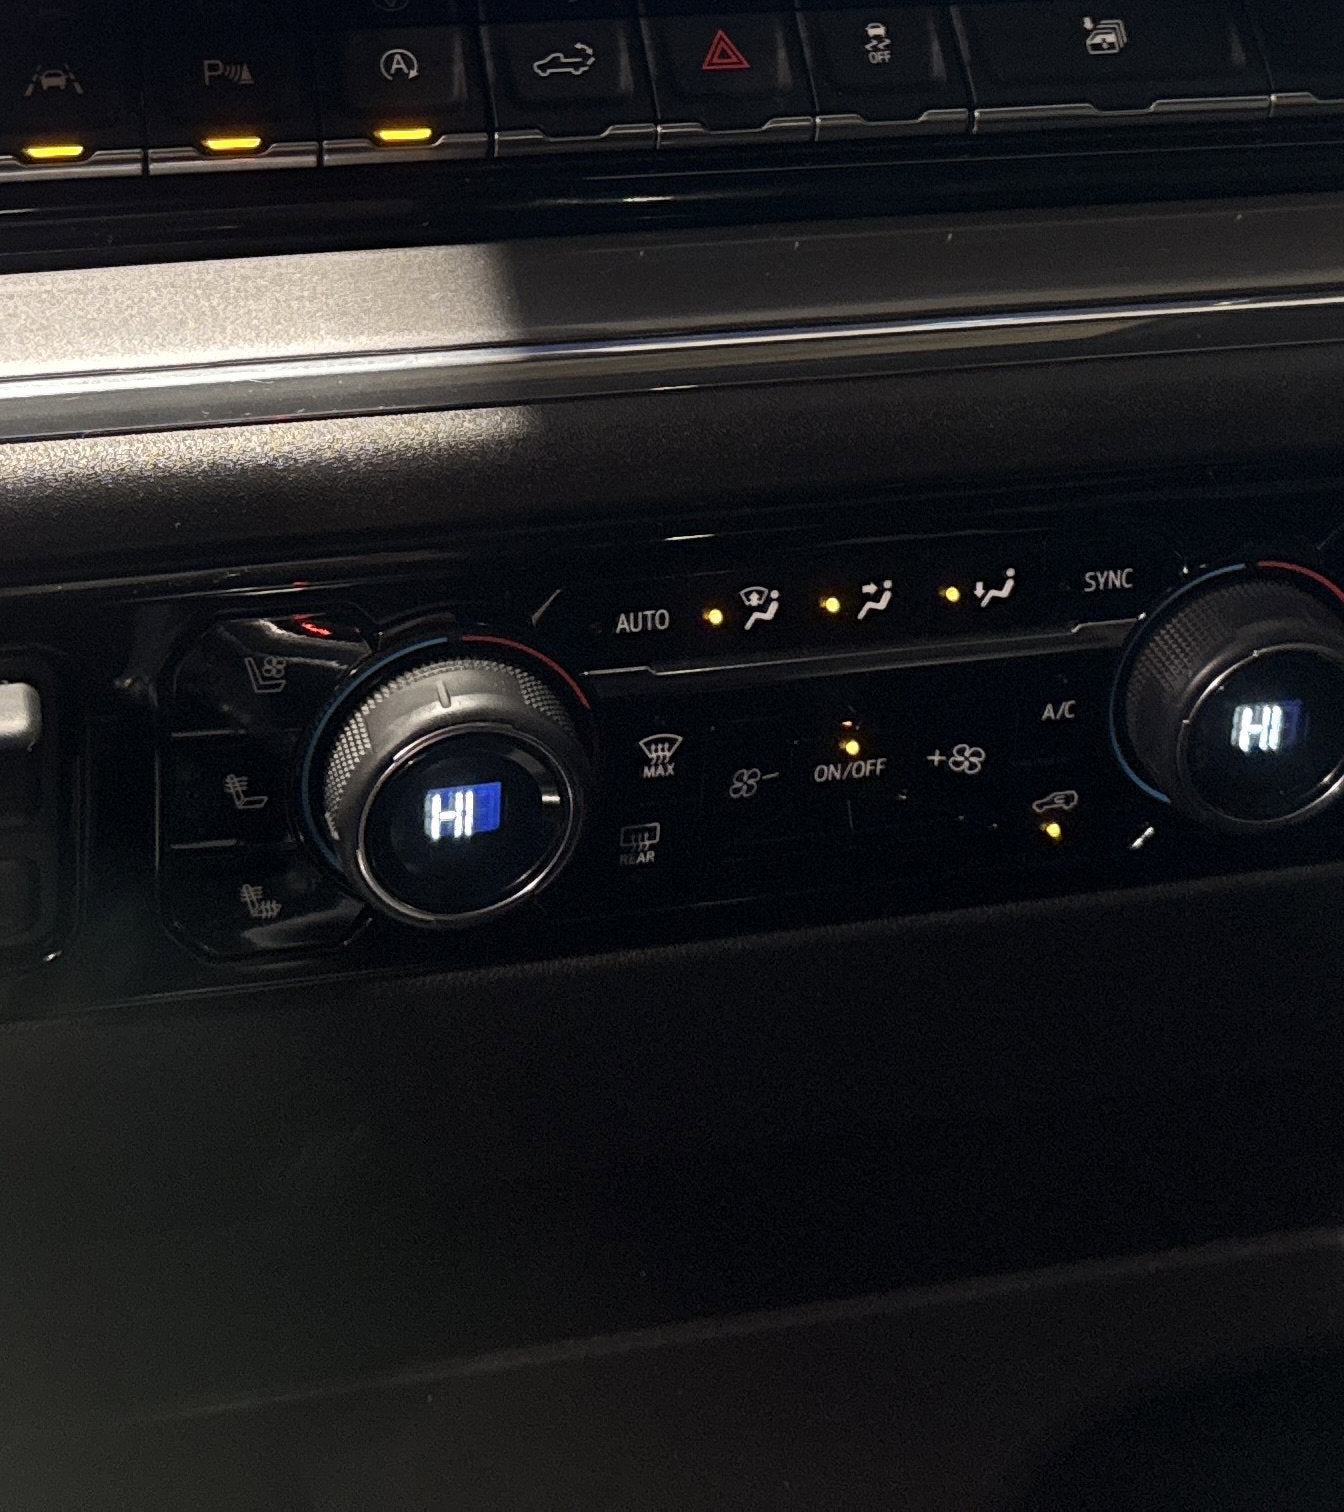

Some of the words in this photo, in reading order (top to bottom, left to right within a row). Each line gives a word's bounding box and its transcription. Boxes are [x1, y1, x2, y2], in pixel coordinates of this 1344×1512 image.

[867, 50, 892, 66] OFF
[1083, 567, 1134, 593] SYNC
[615, 608, 670, 634] AUTO
[1041, 699, 1077, 721] A/C
[1239, 705, 1283, 753] HI
[642, 763, 676, 779] MAX
[813, 757, 888, 783] ON/OFF
[431, 789, 474, 840] HI
[619, 850, 656, 866] REAR
